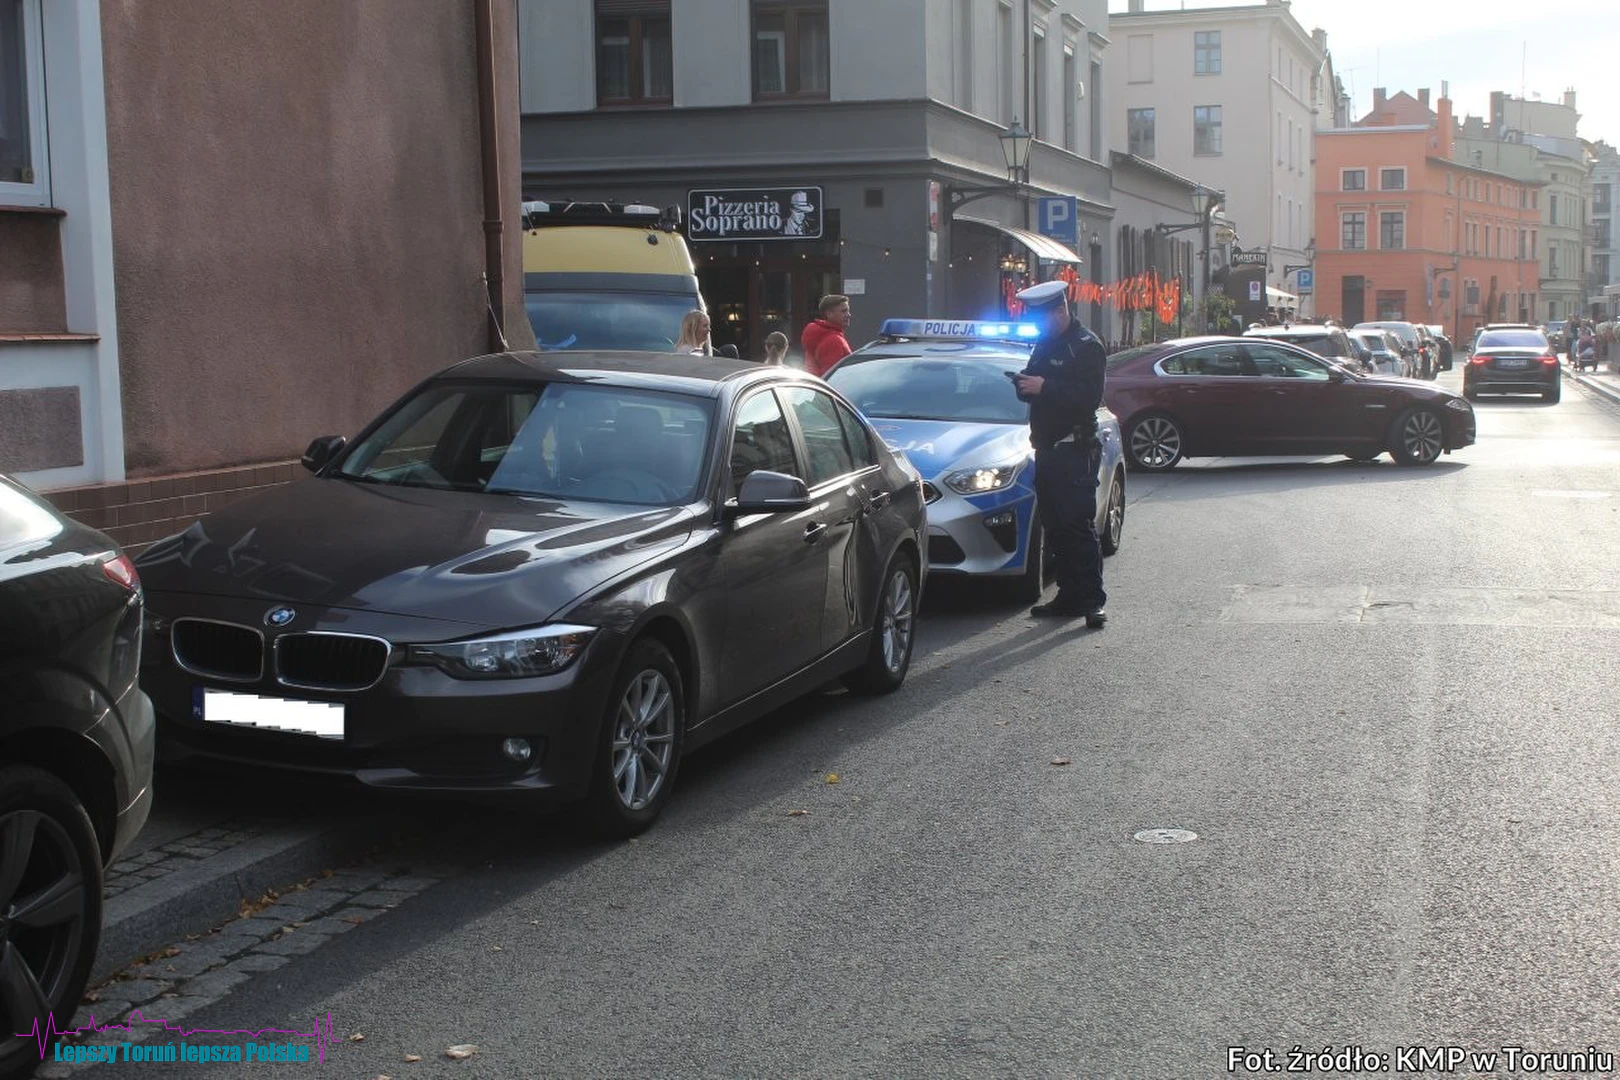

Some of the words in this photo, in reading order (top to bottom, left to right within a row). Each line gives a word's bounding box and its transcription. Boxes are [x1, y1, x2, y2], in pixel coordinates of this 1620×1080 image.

[705, 195, 780, 215] Pizzeria
[1047, 200, 1068, 230] P
[692, 208, 782, 235] Soprano
[924, 322, 976, 335] POLICJA
